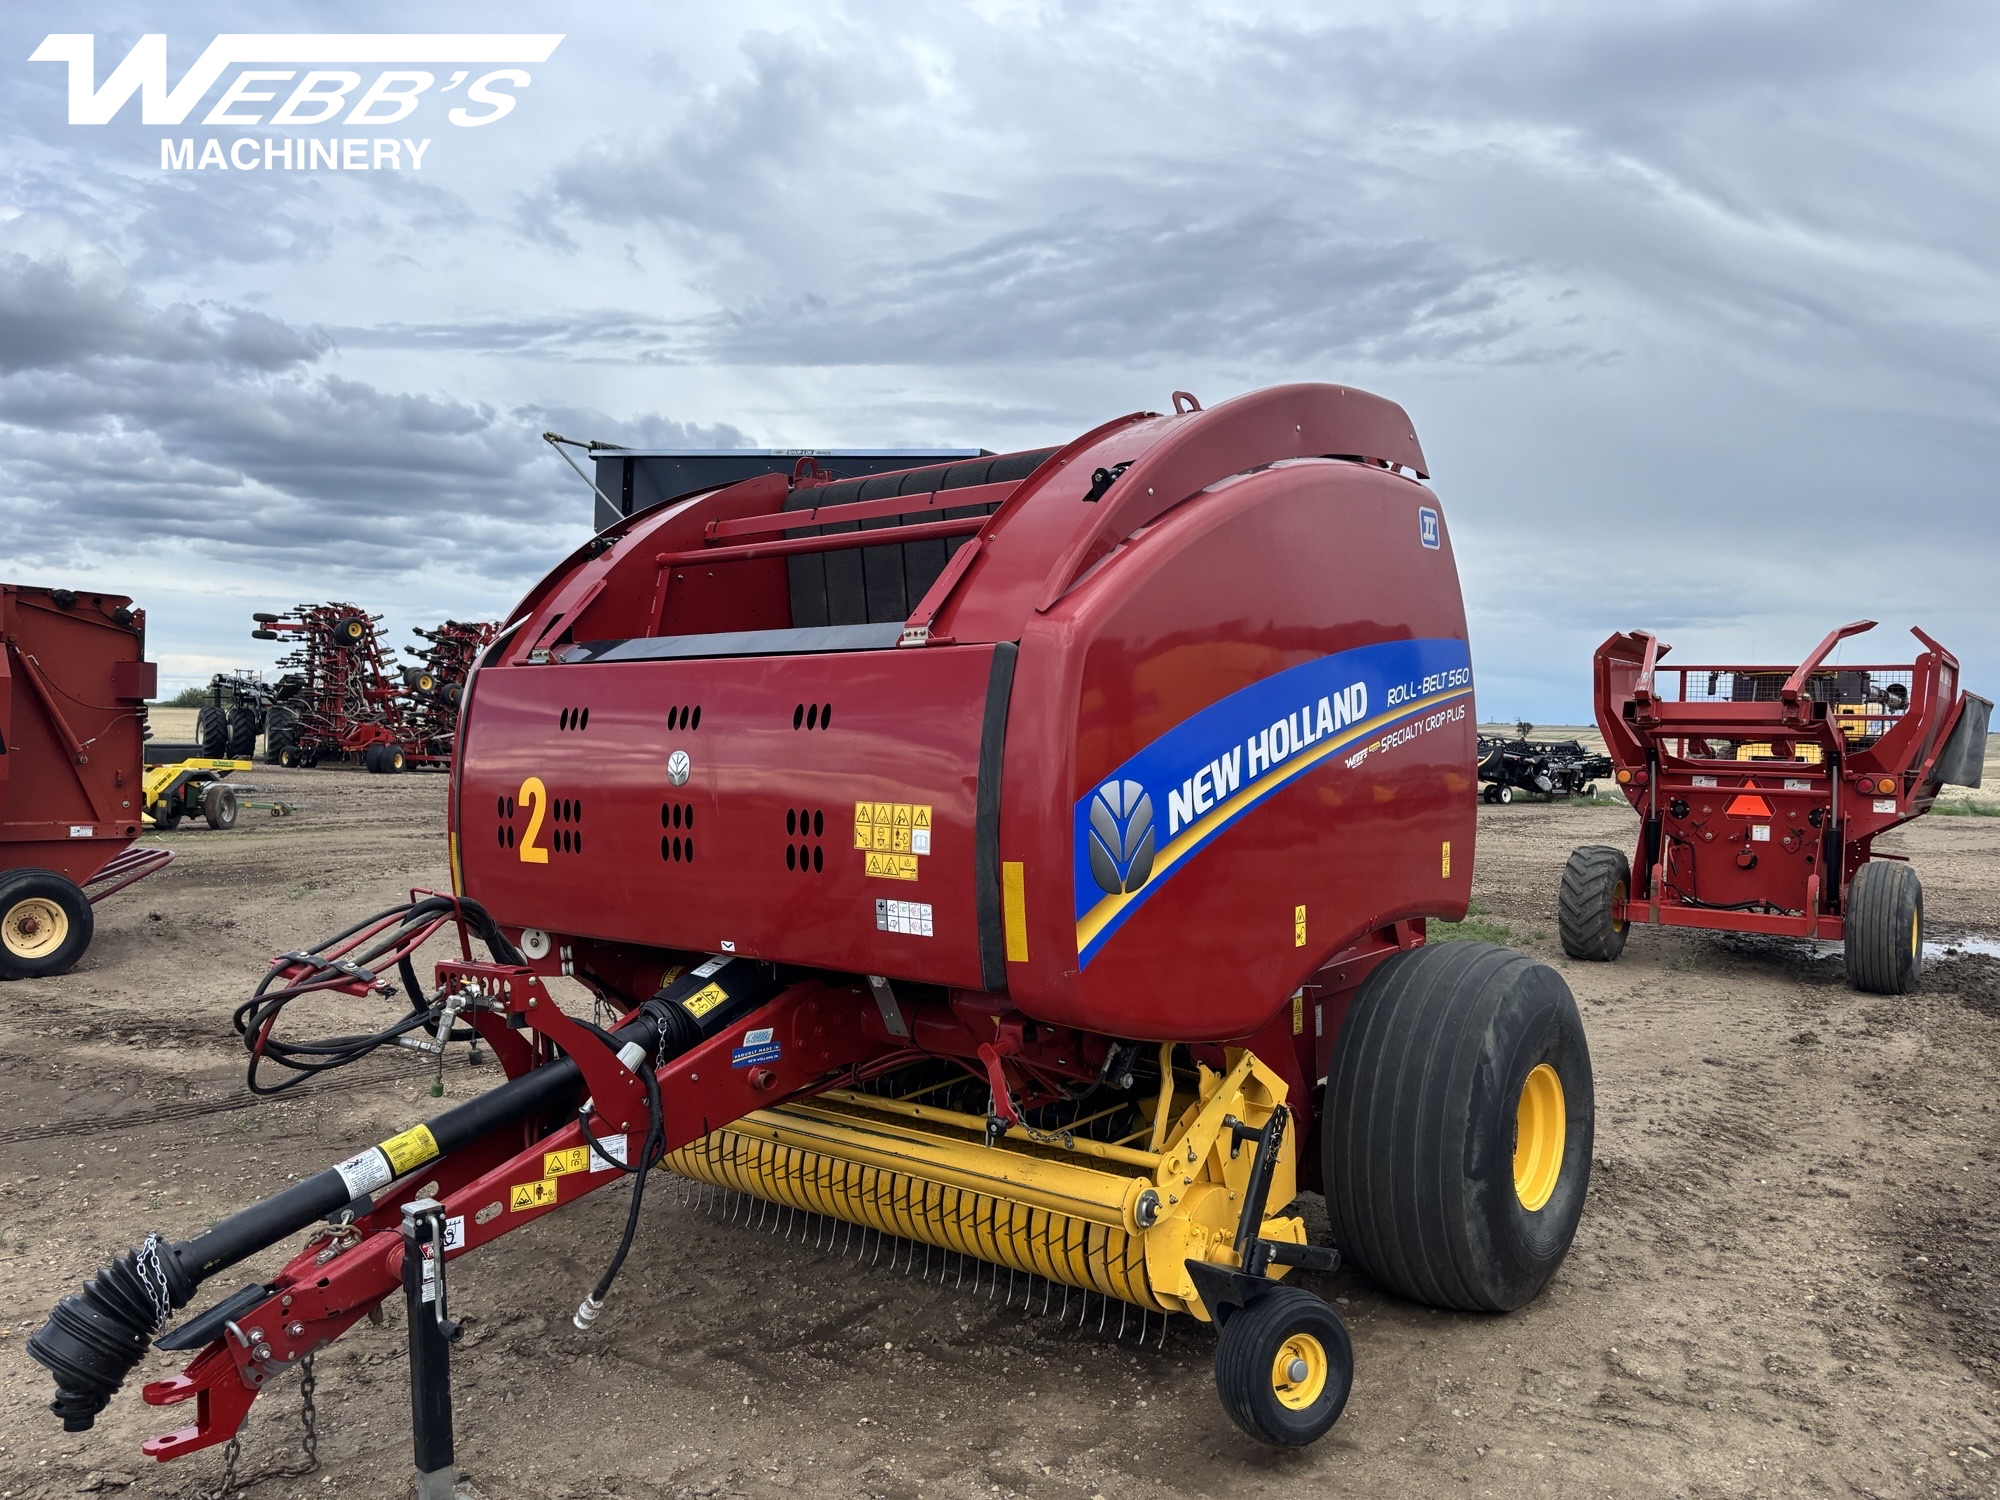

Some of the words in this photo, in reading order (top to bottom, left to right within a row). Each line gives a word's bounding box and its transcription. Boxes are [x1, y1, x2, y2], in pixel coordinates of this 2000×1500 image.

[1447, 667, 1469, 688] 560
[1381, 719, 1425, 754] SPECIALTY
[1425, 711, 1446, 733] CROP
[1446, 704, 1465, 725] PLUS
[1168, 744, 1241, 837] NEW
[1247, 681, 1369, 779] HOLLAND
[518, 776, 549, 864] 2
[735, 1050, 758, 1059] PROUDLY
